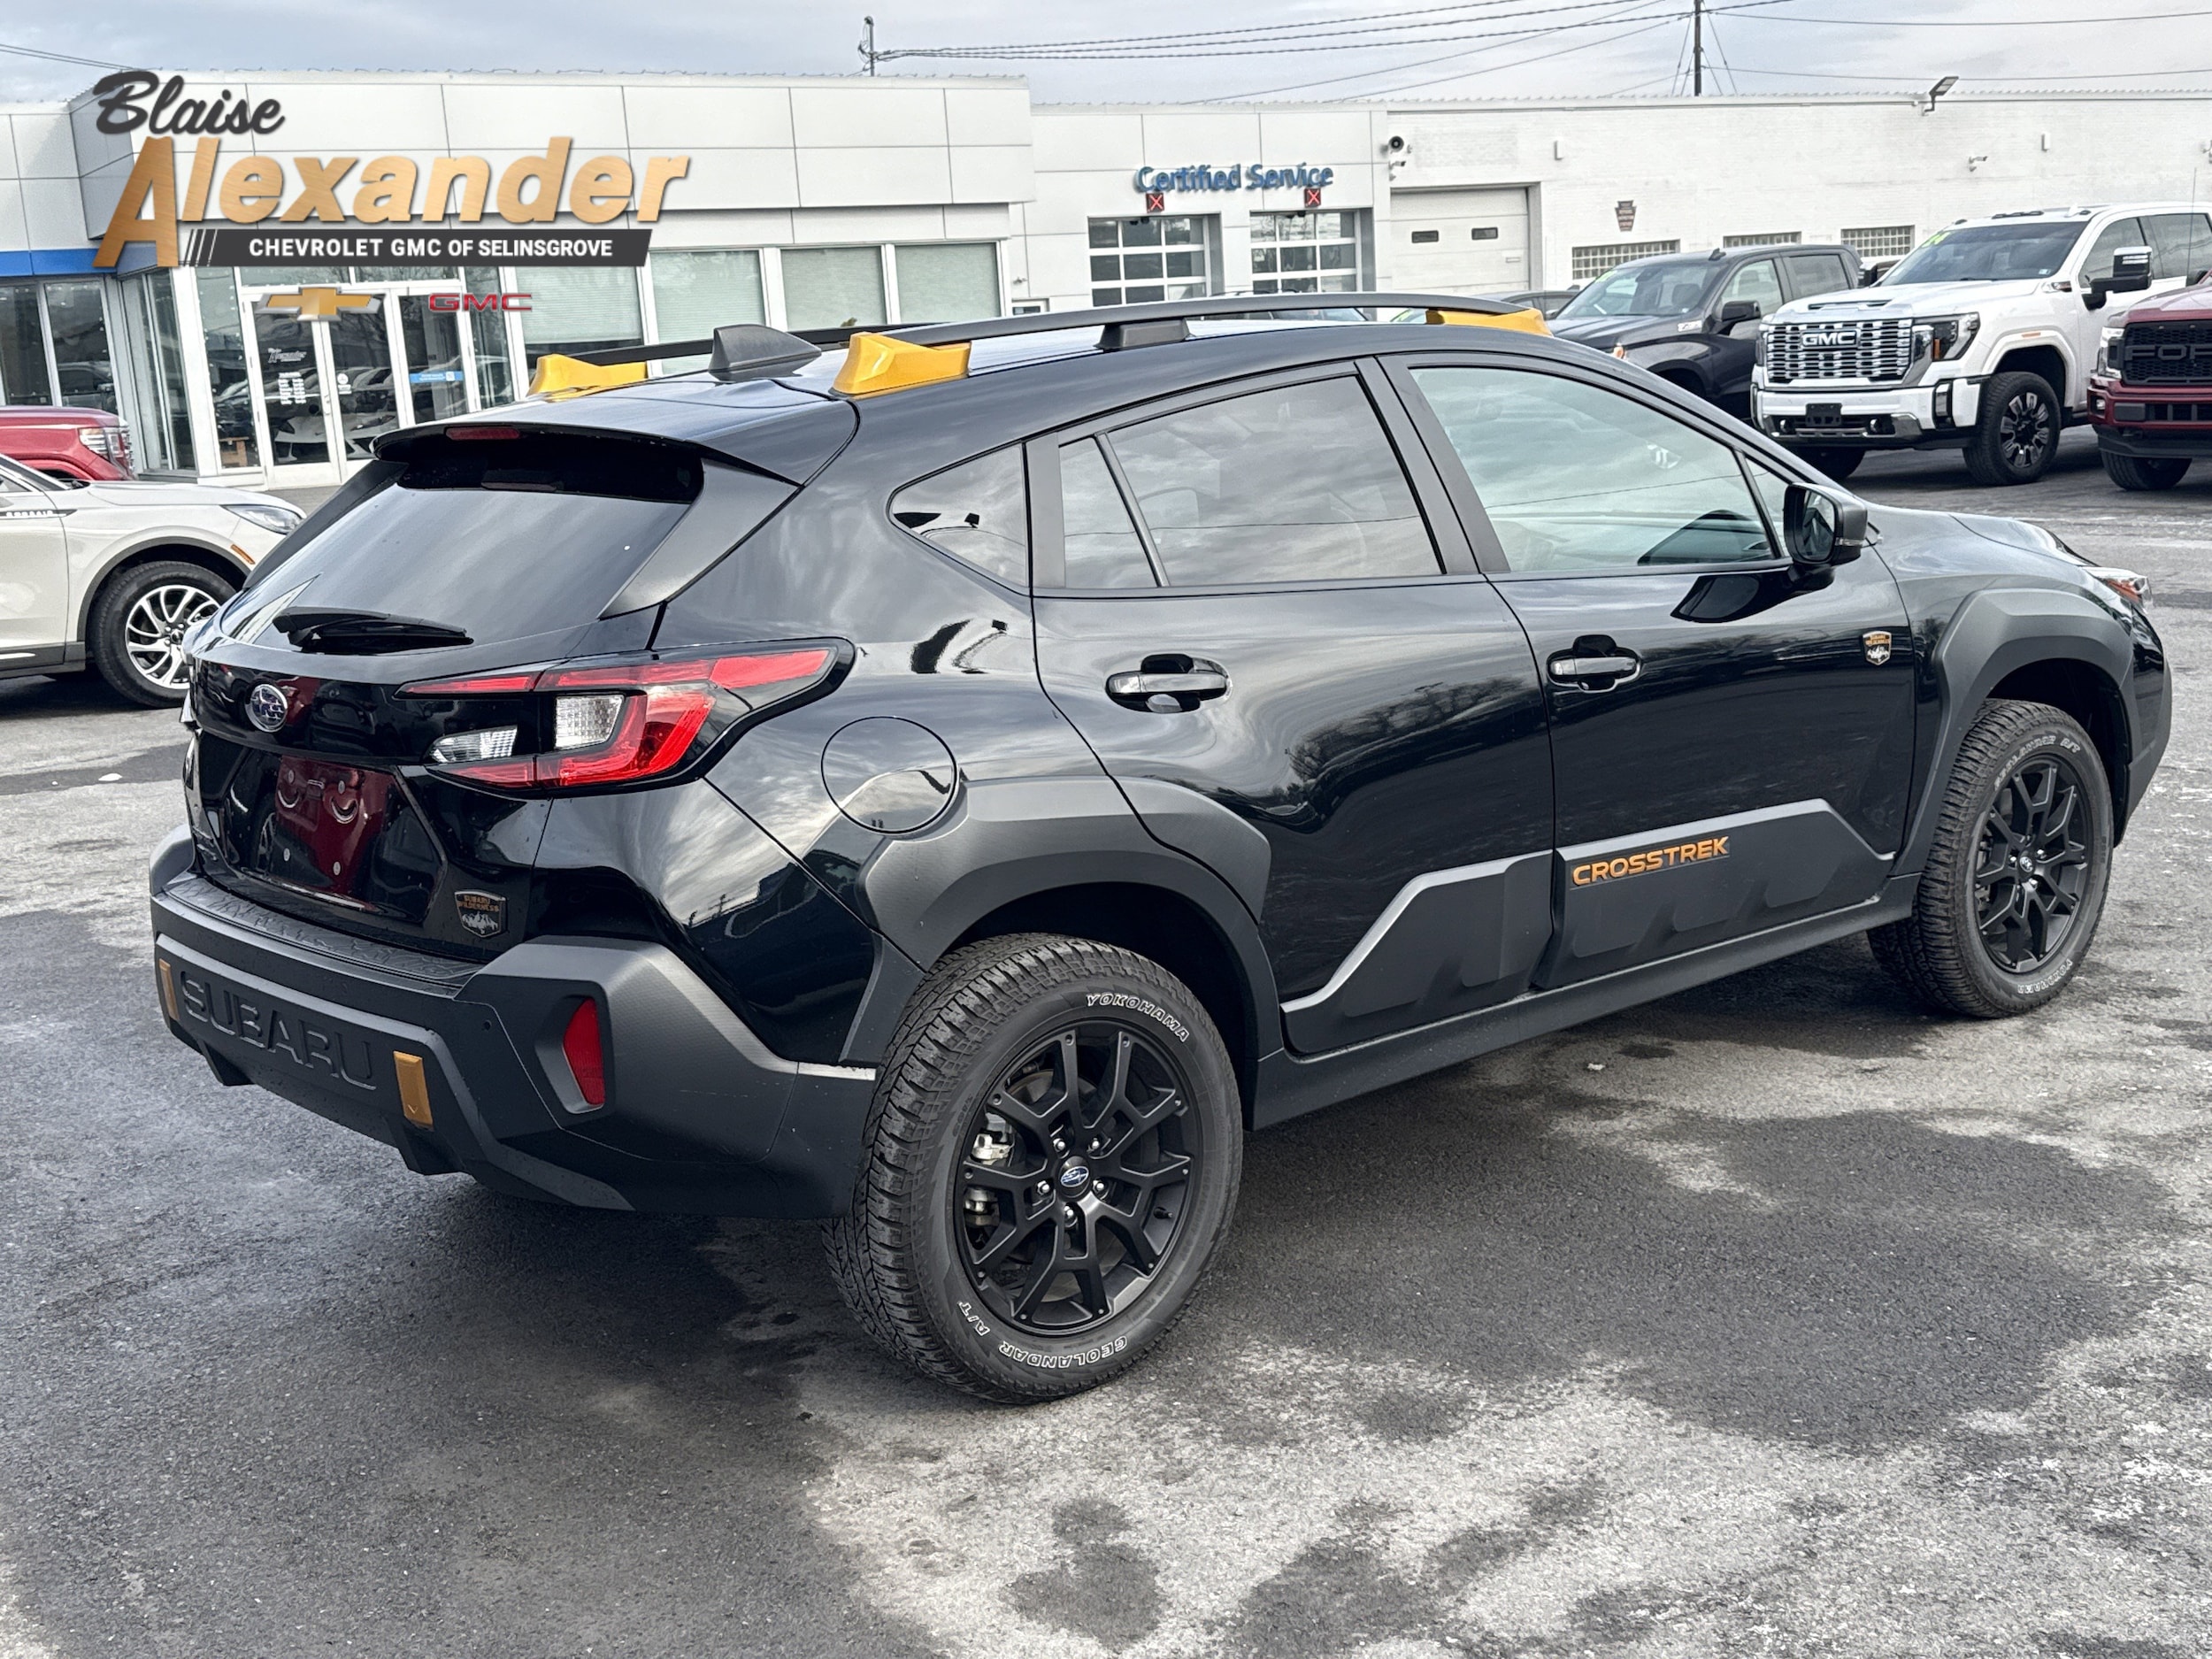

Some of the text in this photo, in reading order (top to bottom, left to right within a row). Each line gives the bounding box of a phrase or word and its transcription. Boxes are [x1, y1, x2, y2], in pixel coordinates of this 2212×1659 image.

[1134, 162, 1333, 193] Certified Service
[1802, 332, 1856, 346] GMC
[1572, 836, 1730, 887] CROSSTREK
[180, 971, 377, 1091] SUBARU
[1086, 991, 1190, 1042] YOKOHAMA
[956, 1301, 1128, 1370] GEOLANDAR A/T
